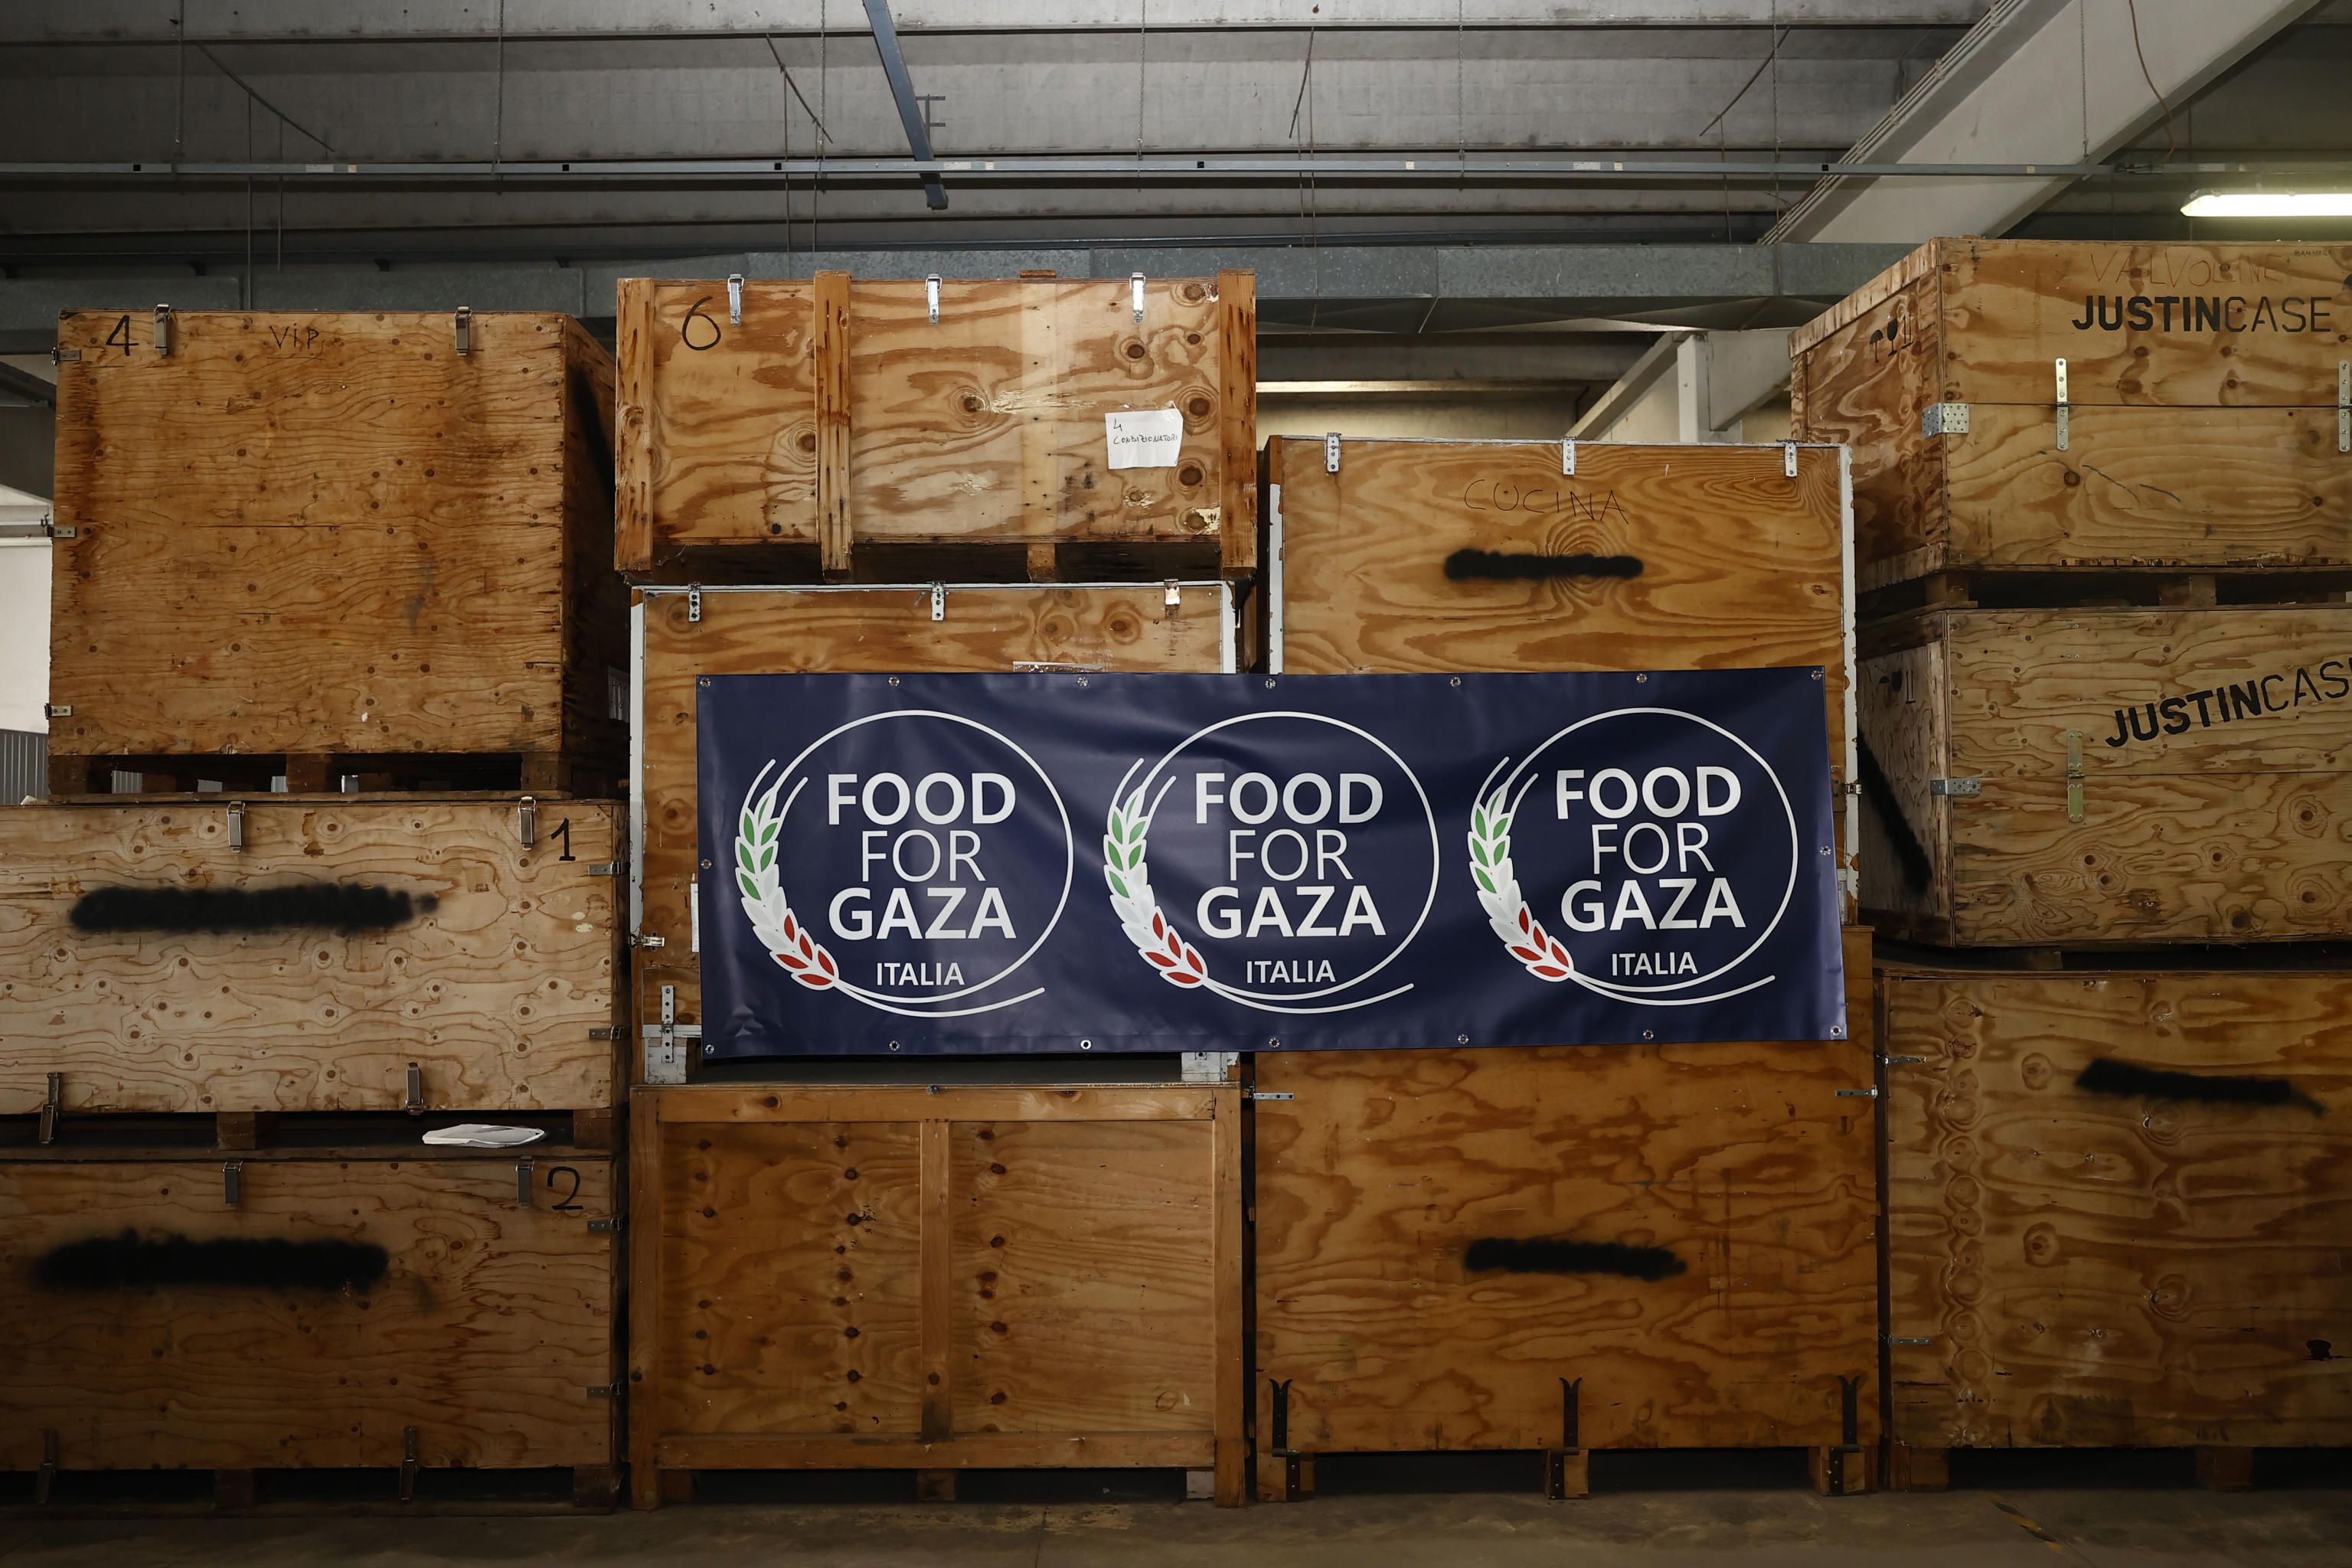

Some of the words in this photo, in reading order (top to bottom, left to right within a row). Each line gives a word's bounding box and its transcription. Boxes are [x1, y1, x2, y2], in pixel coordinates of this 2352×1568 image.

[2089, 250, 2282, 289] VALVOLINE
[106, 315, 139, 357] 4
[682, 296, 721, 351] 6
[2071, 295, 2332, 333] JUSTINCASE
[1113, 418, 1122, 431] 4
[1464, 479, 1629, 524] CUCINA
[2105, 657, 2352, 748] JUSTINCAS
[828, 772, 1017, 826] FOOD
[1195, 772, 1384, 825] FOOD
[1556, 766, 1743, 820] FOOD
[550, 818, 577, 862] 1
[861, 828, 987, 883] FOR
[1229, 828, 1354, 882] FOR
[1591, 822, 1716, 875] FOR
[828, 887, 1018, 941] GAZA
[1196, 884, 1387, 939] GAZA
[1560, 877, 1747, 933] GAZA
[877, 962, 965, 986] ITALIA
[1246, 959, 1337, 984] ITALIA
[1611, 951, 1699, 976] ITALIA
[547, 1166, 584, 1210] 2
